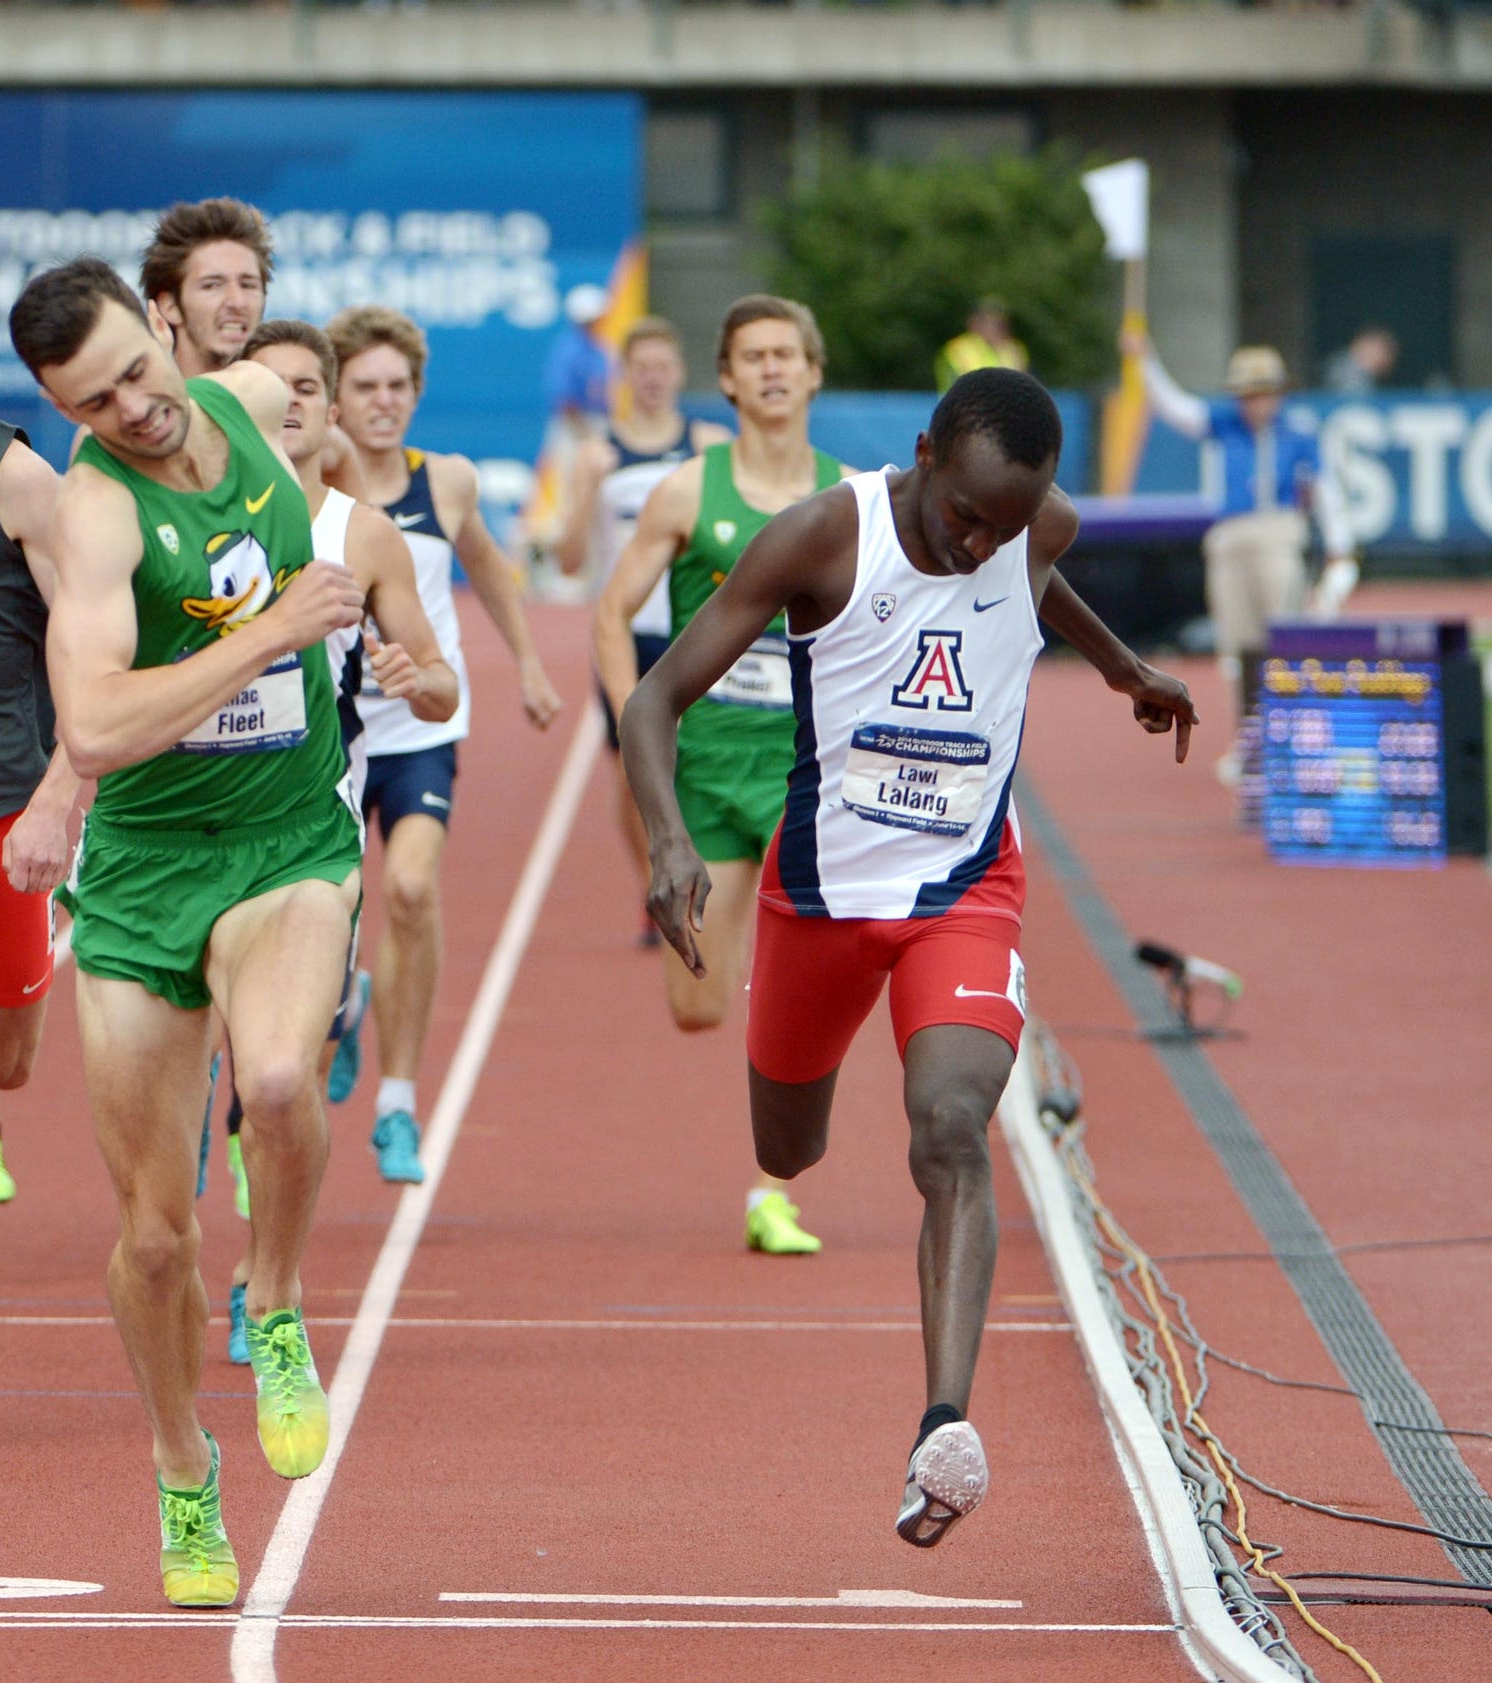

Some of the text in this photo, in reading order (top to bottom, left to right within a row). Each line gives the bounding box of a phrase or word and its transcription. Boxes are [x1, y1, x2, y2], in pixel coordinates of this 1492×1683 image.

[890, 629, 974, 713] A
[218, 708, 265, 735] Fleet
[895, 742, 986, 758] CHAMPIONSHIPS
[898, 764, 939, 785] Lawi
[877, 782, 948, 817] Lalang
